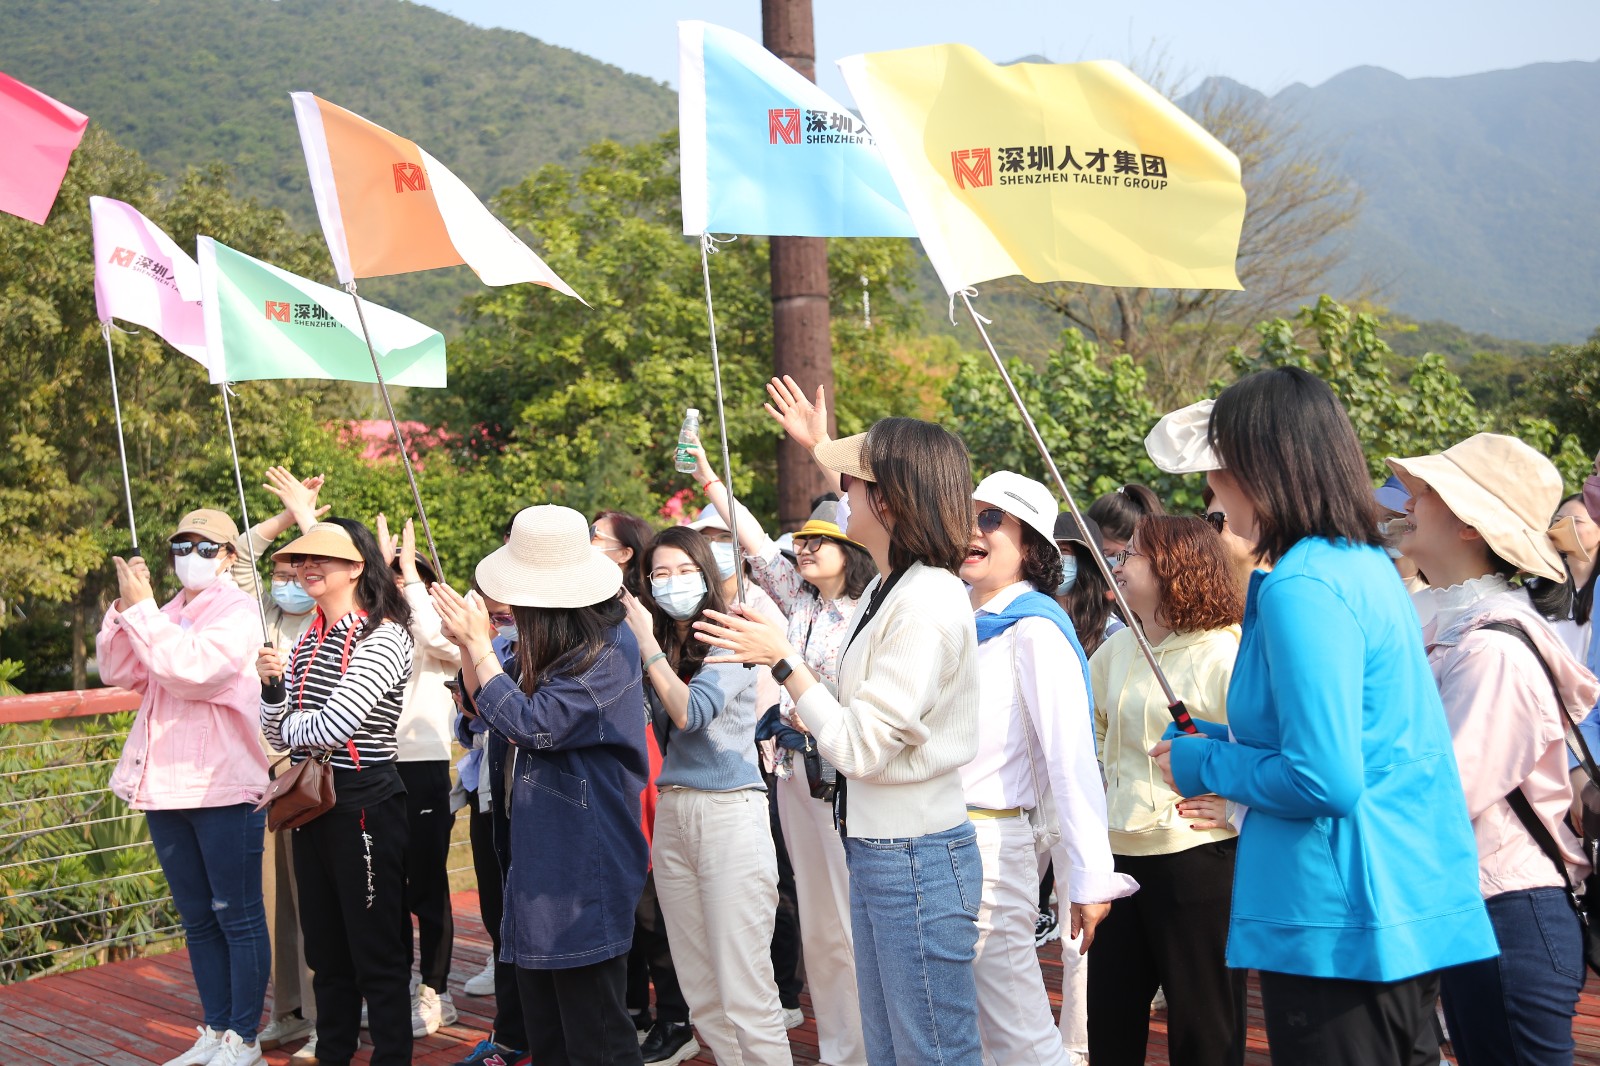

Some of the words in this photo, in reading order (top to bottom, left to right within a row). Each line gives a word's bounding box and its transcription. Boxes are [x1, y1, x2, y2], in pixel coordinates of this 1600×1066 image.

[806, 134, 864, 144] SHENZHEN
[998, 145, 1168, 179] 深圳人才集团
[1000, 173, 1069, 186] SHENZHEN
[1073, 173, 1120, 187] TALENT
[1124, 177, 1168, 191] GROUP
[132, 265, 170, 286] SHENZHEN
[171, 284, 181, 295] TA
[294, 303, 335, 320] 深圳
[294, 319, 337, 328] SHENZHEN
